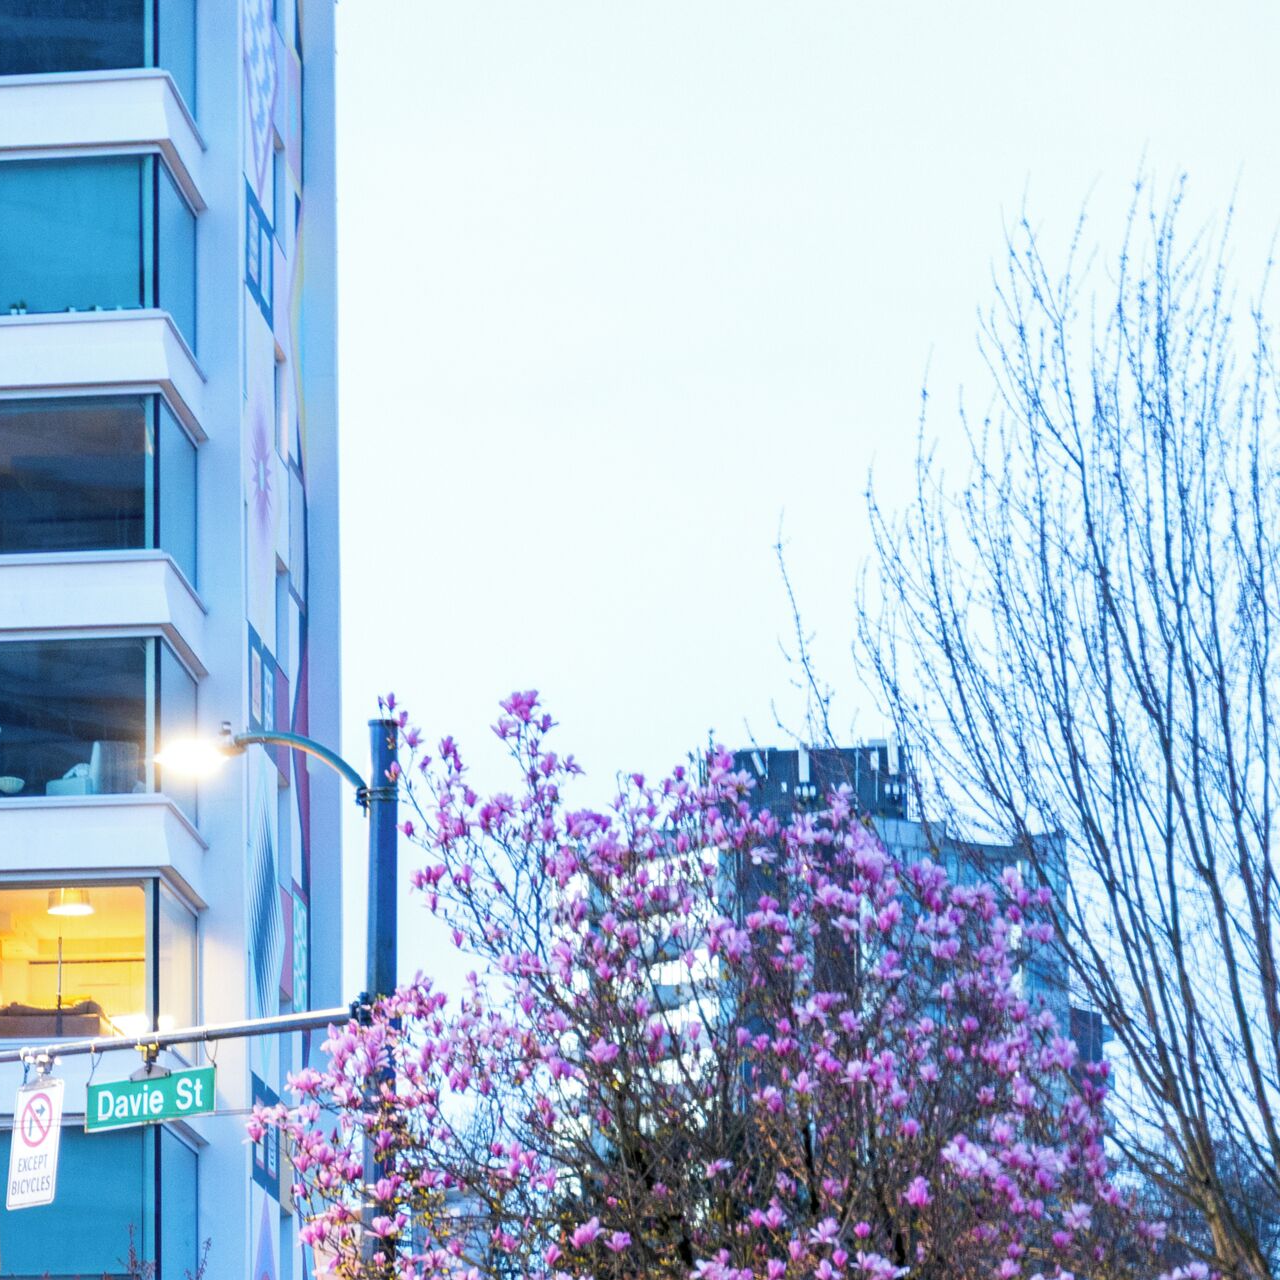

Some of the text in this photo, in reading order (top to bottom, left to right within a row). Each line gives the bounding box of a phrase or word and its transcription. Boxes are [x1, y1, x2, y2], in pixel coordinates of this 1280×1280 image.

[97, 1077, 203, 1121] Davie St
[17, 1153, 49, 1173] EXCEPT
[11, 1175, 51, 1196] BICYCLES
